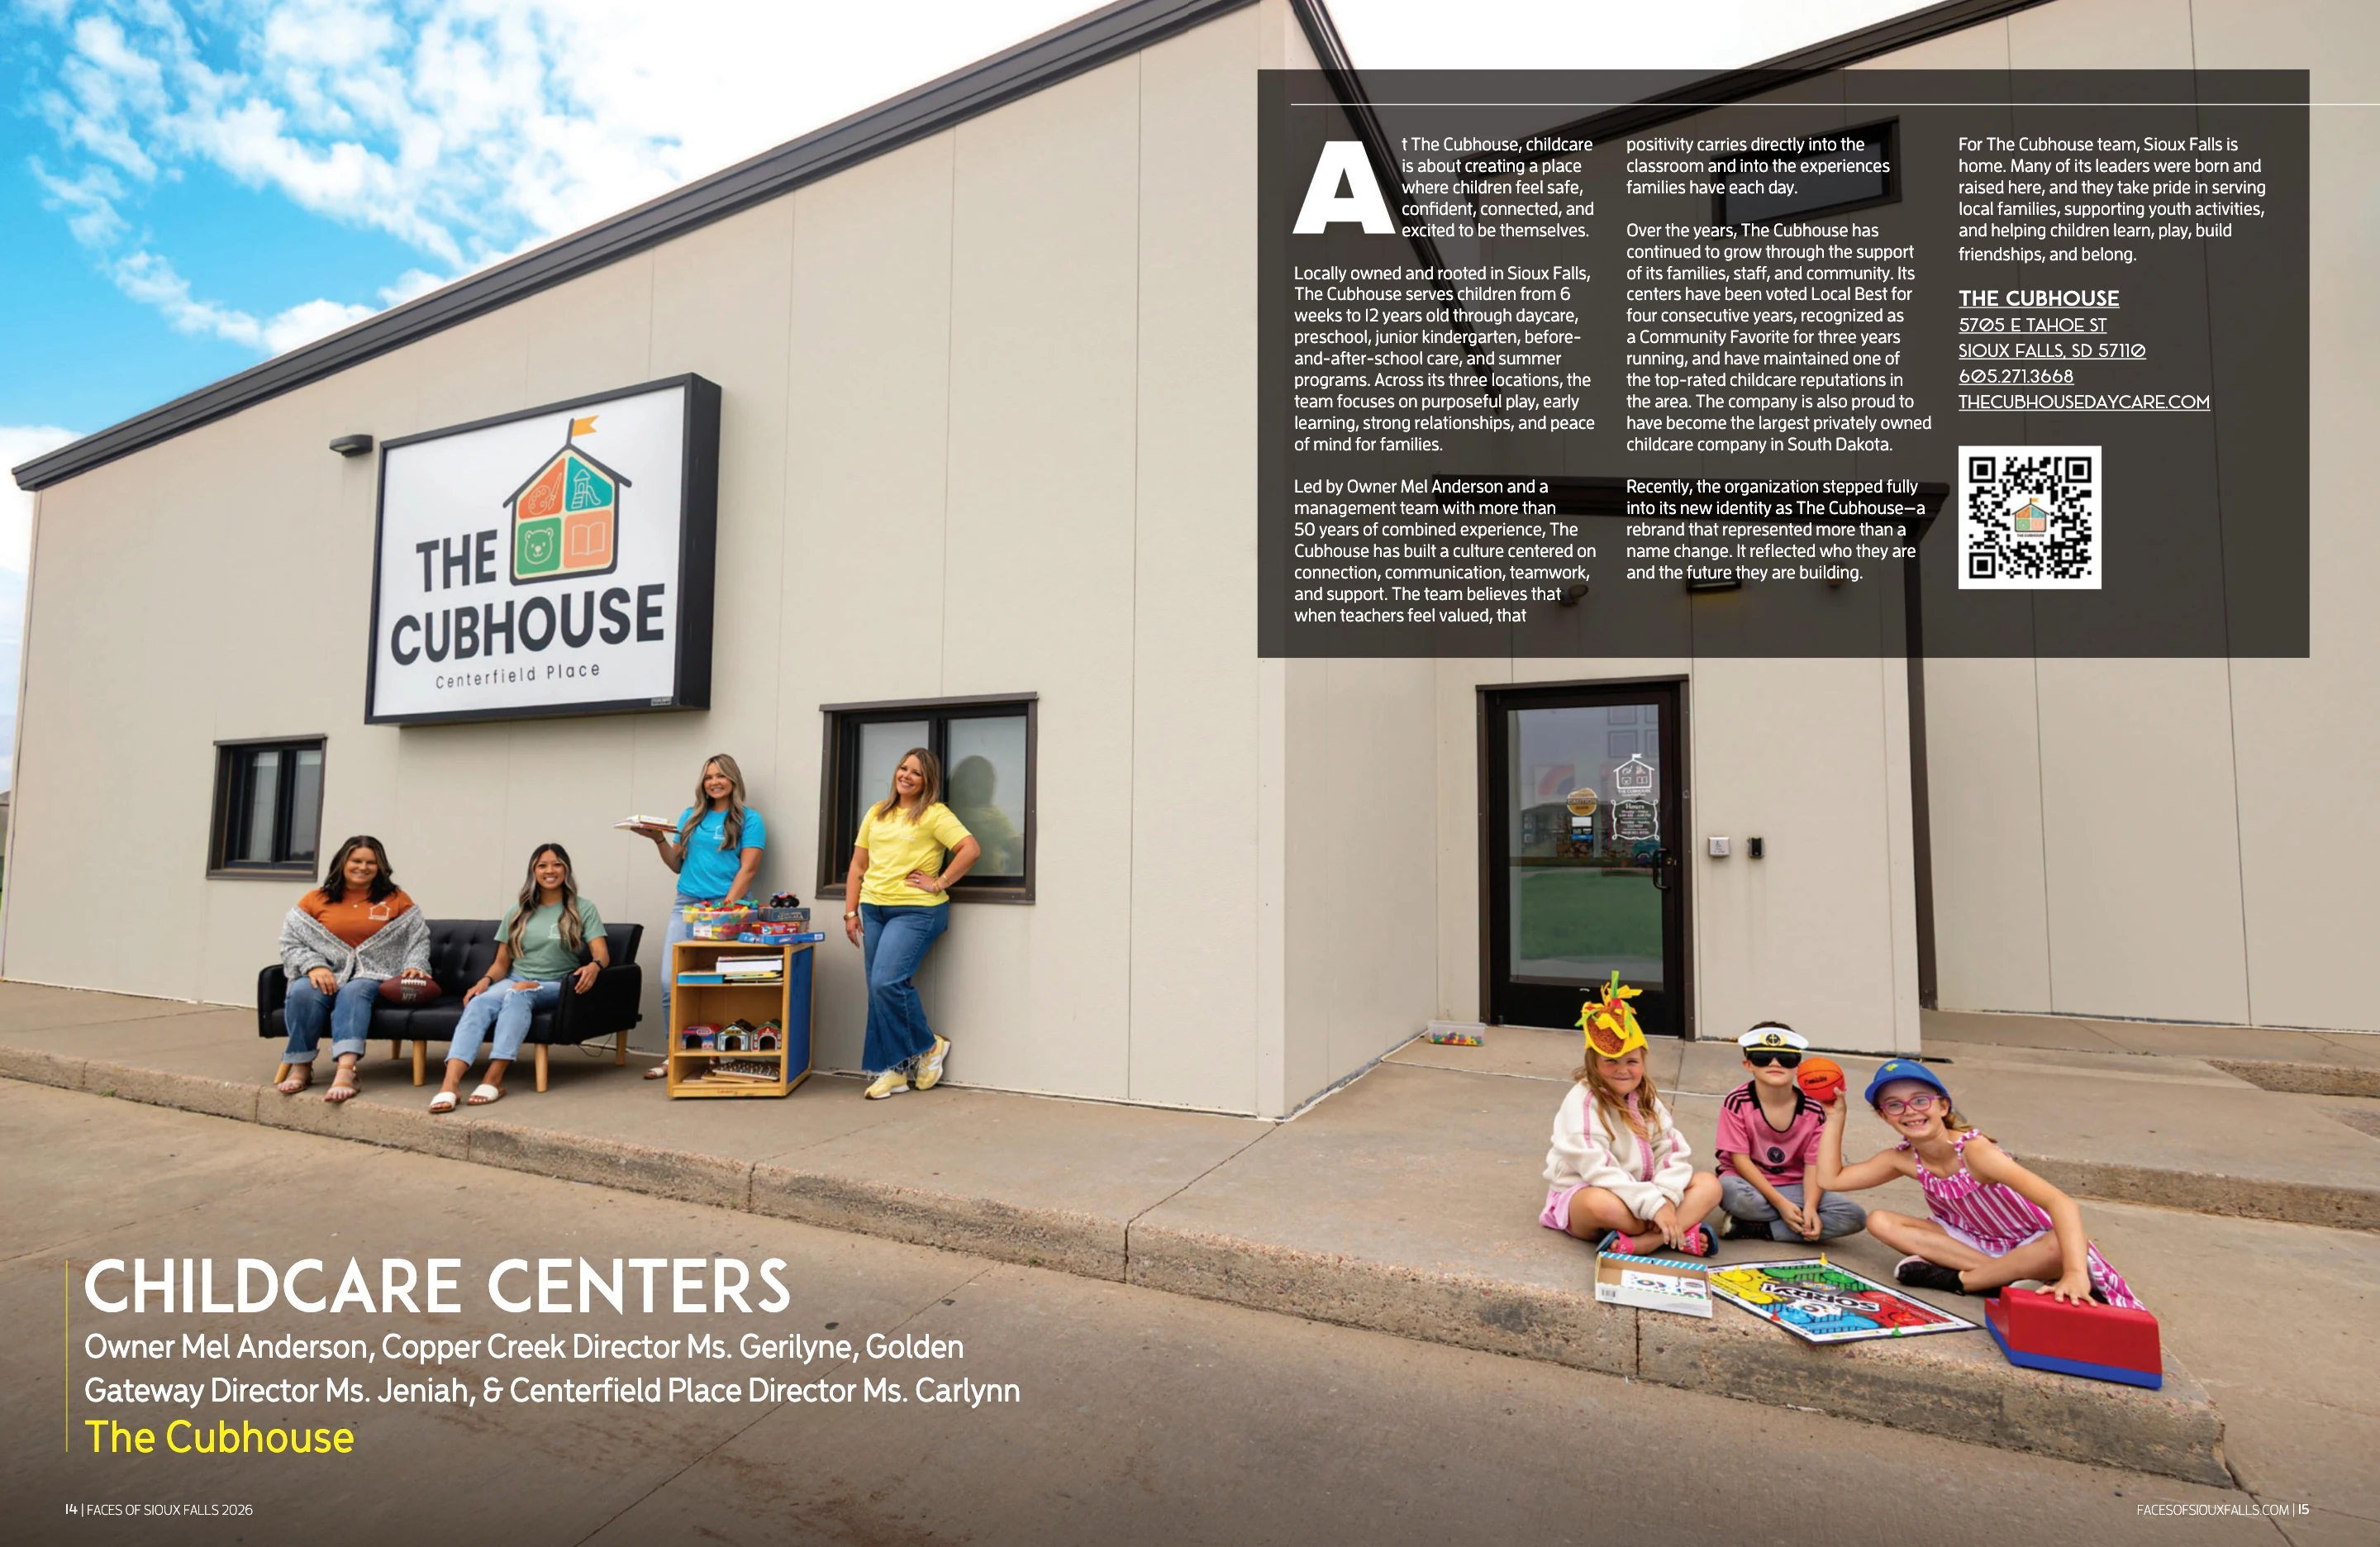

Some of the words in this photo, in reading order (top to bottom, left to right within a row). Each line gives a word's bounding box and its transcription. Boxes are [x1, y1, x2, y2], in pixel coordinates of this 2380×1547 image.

[416, 529, 497, 593] THE
[391, 583, 665, 666] CUBHOUSE
[436, 667, 536, 689] Centerfield
[547, 664, 600, 679] Place
[1762, 1283, 1880, 1312] SORRY!
